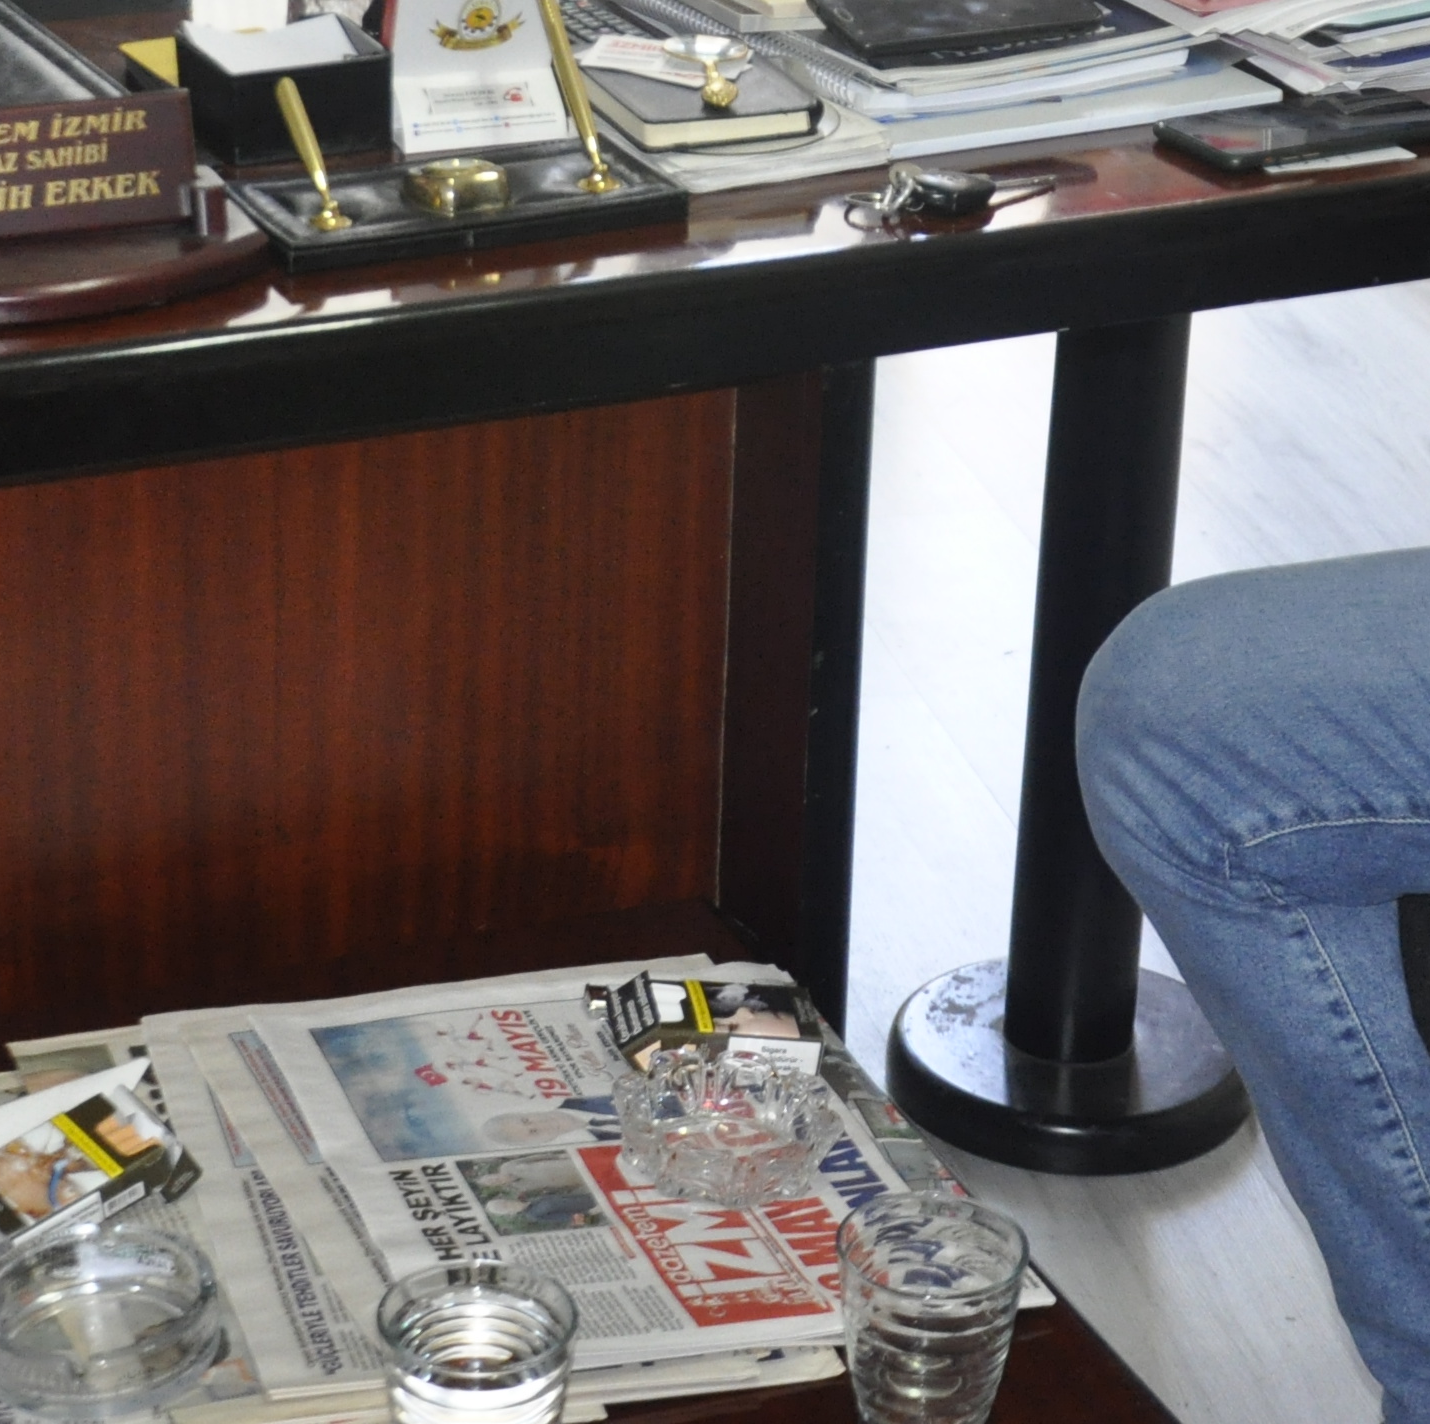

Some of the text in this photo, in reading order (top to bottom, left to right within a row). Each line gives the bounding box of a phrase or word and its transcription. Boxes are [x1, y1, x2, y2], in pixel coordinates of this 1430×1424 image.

[27, 139, 109, 171] SAHİBİ
[50, 107, 147, 139] İZMİR
[44, 171, 161, 208] ERKEK
[491, 1009, 572, 1100] 19 MAYIS
[388, 1169, 465, 1261] HER ŞEYİN
[421, 1162, 494, 1246] LAYIKTIR
[621, 1205, 693, 1285] gazetem
